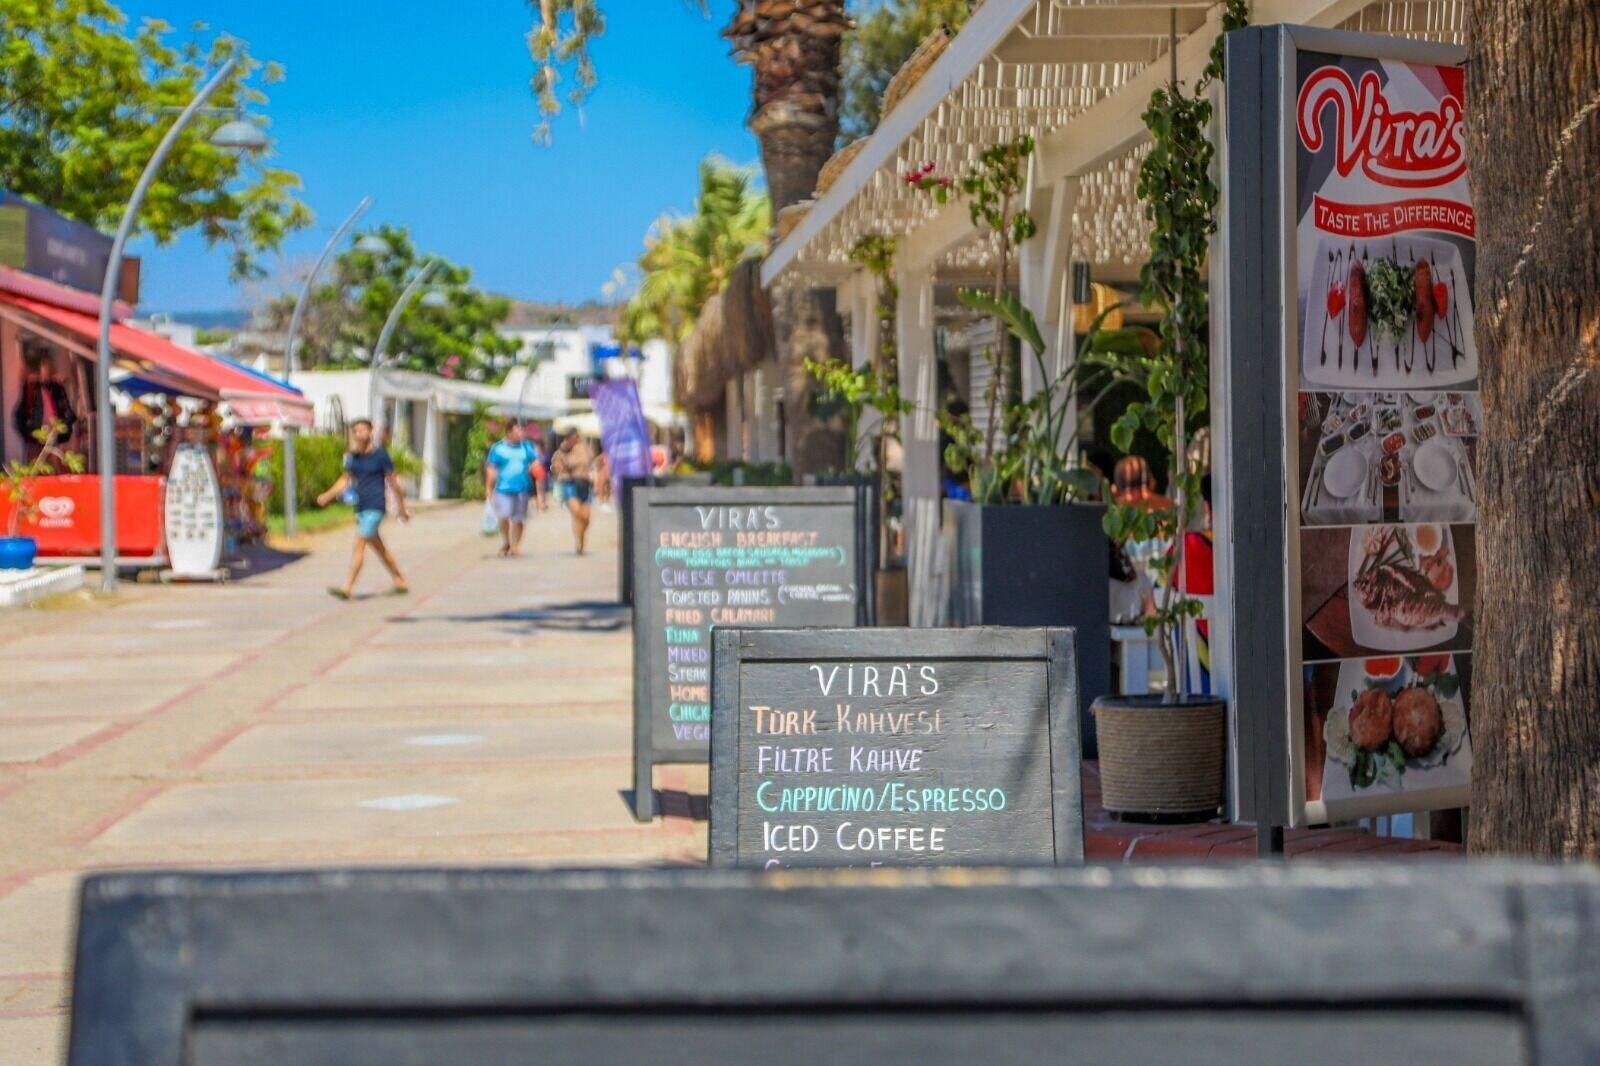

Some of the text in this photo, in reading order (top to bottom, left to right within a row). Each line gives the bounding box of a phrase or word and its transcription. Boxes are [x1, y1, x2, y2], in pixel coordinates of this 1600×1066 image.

[1297, 66, 1467, 188] Vira's
[1319, 205, 1474, 232] TASTE THE DIFFERENCE
[661, 567, 714, 586] CHEESE
[662, 587, 721, 606] TOASTED
[665, 606, 775, 625] FRIED CALAMARI
[664, 625, 699, 644] TUNA
[667, 645, 707, 662] MIXED
[668, 662, 708, 682] STEAK
[670, 684, 709, 702] HOME
[850, 746, 923, 772] KAHVE
[763, 821, 946, 852] ICED COFFEE
